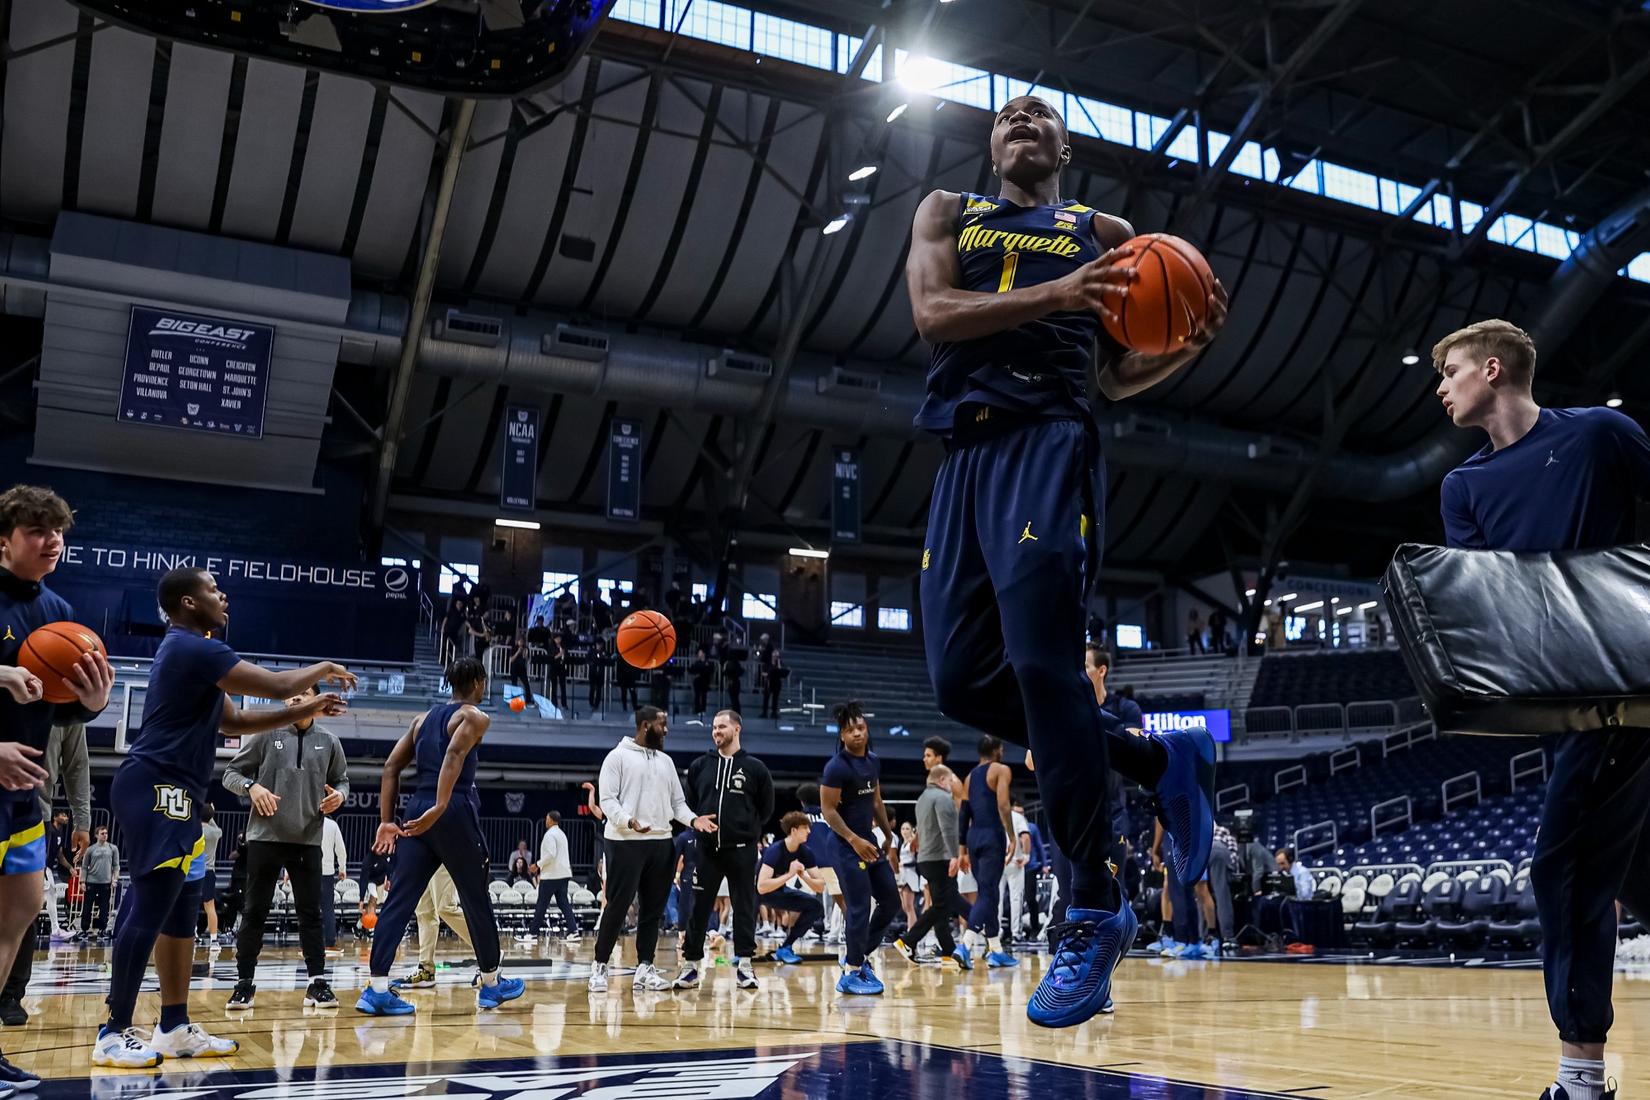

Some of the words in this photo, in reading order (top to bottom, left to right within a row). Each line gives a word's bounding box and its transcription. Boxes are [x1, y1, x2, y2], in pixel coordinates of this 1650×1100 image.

[958, 224, 1081, 258] Marquette
[998, 251, 1020, 293] 1
[156, 318, 197, 332] BIG
[194, 323, 255, 341] EAST
[151, 349, 173, 360] BUTLER
[189, 354, 209, 366] UCONN
[178, 366, 217, 380] GEORGETOWN
[225, 359, 257, 373] CREIGHTON
[133, 372, 169, 387] PROVIDENCE
[179, 379, 199, 391] SETON
[198, 382, 212, 393] HALL
[224, 372, 257, 386] MARQUETTE
[136, 386, 167, 400] VILLANOVA
[221, 398, 242, 409] XAVIER
[509, 421, 535, 439] NCAA
[92, 547, 127, 568] TO
[228, 559, 376, 589] FIELDHOUSE
[385, 591, 407, 600] pepsi
[1144, 713, 1207, 732] Hilton
[156, 786, 190, 819] MU
